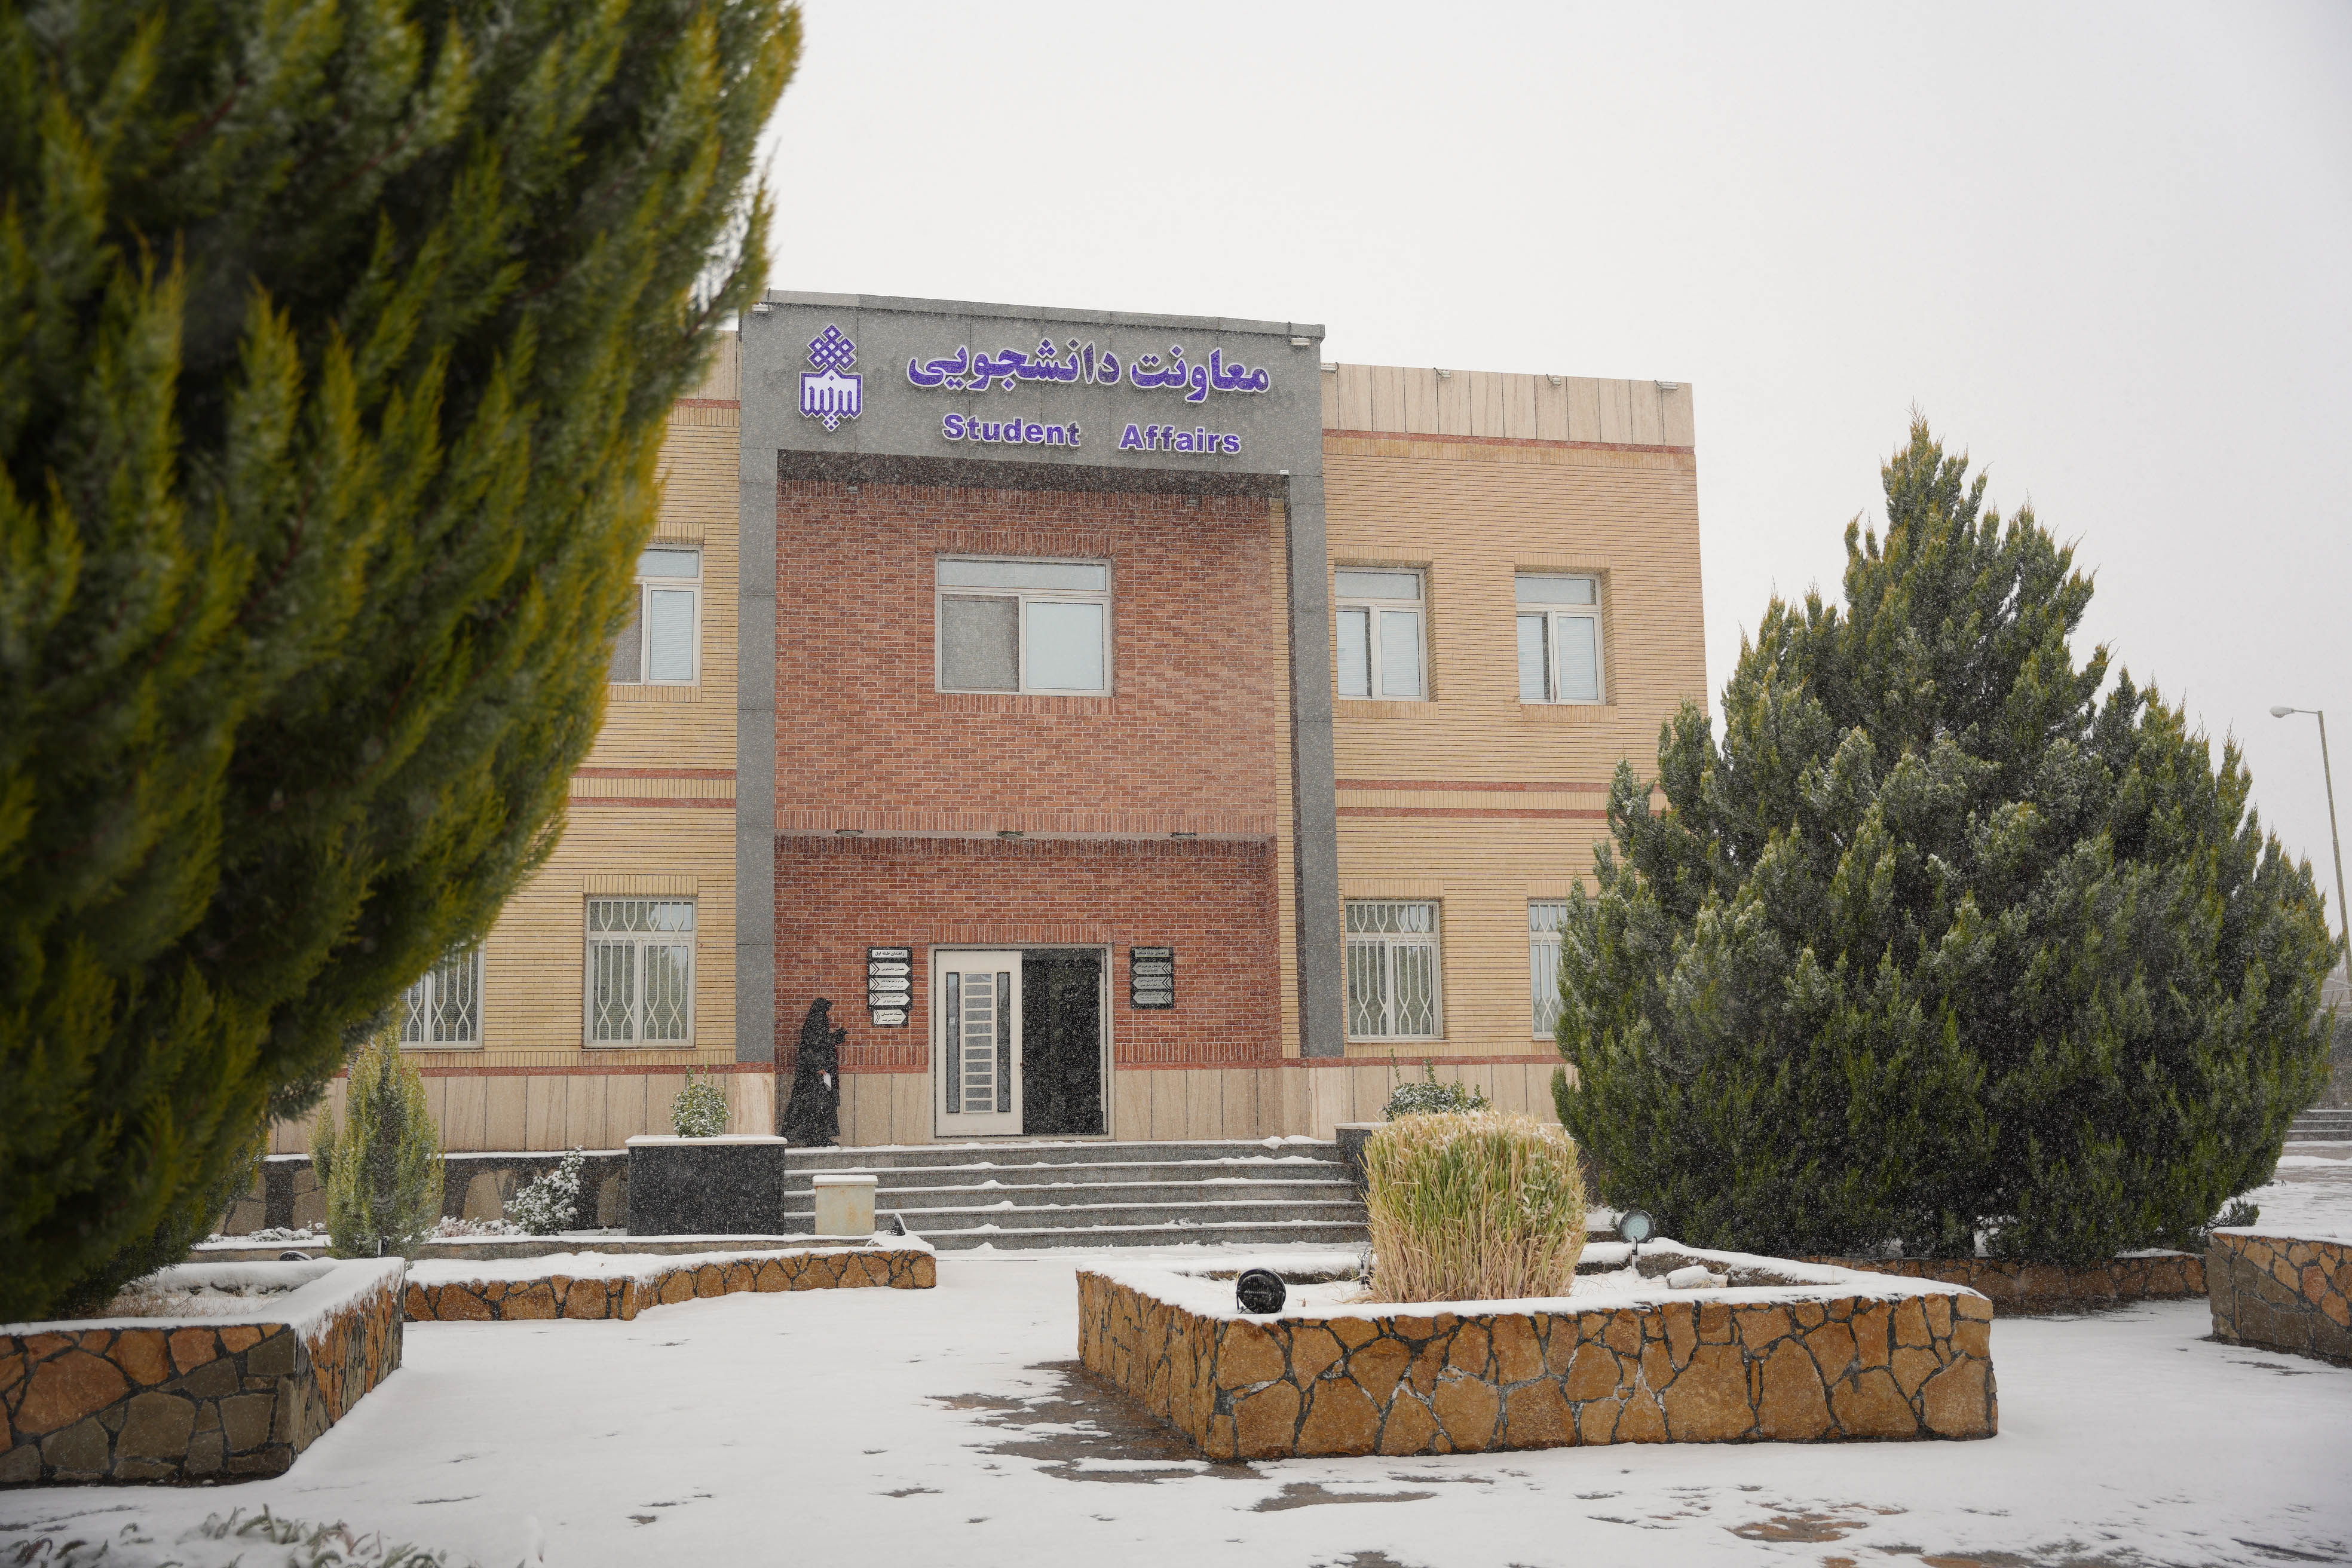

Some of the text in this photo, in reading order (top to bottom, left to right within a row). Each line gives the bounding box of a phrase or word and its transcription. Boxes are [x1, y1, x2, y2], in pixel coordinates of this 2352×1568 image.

[906, 338, 1270, 404] معاونت دانشجویی
[942, 413, 1242, 455] Student Affairs
